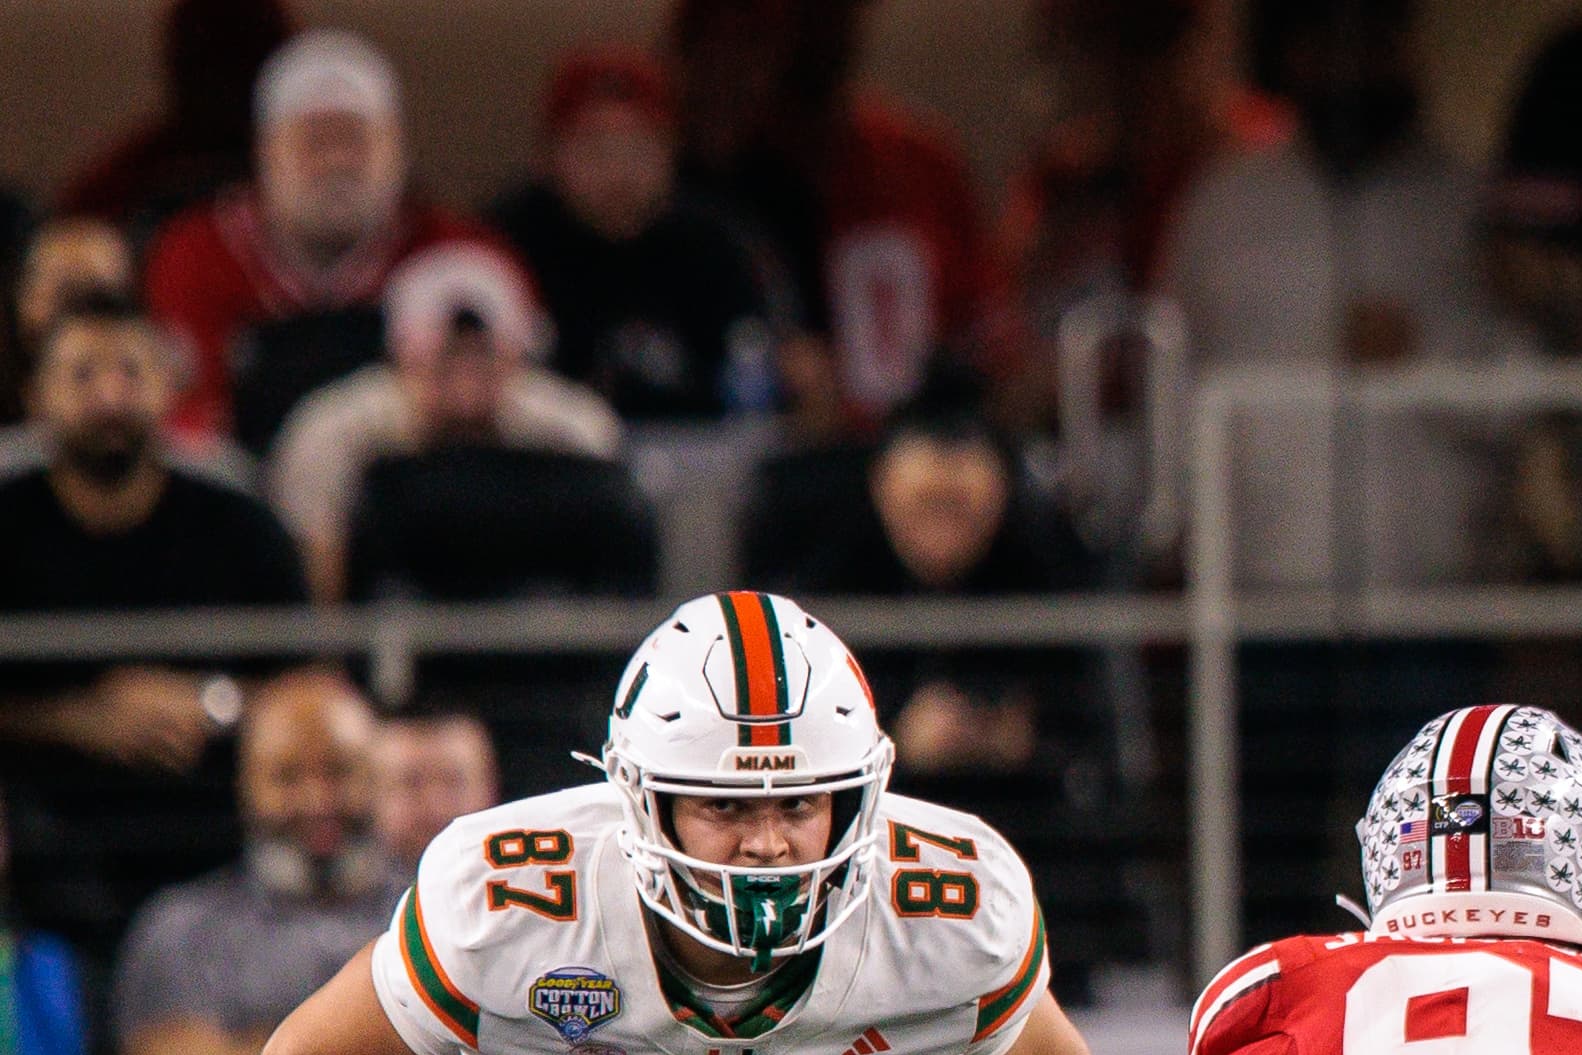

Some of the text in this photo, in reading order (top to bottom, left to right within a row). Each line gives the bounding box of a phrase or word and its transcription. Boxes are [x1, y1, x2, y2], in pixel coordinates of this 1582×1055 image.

[735, 755, 795, 771] MIAMI
[887, 819, 981, 920] 87
[1403, 850, 1422, 871] 97
[484, 828, 577, 921] 87
[1386, 909, 1551, 933] BUCKEYES
[535, 988, 614, 1015] COTTON
[550, 1003, 600, 1018] BOWL
